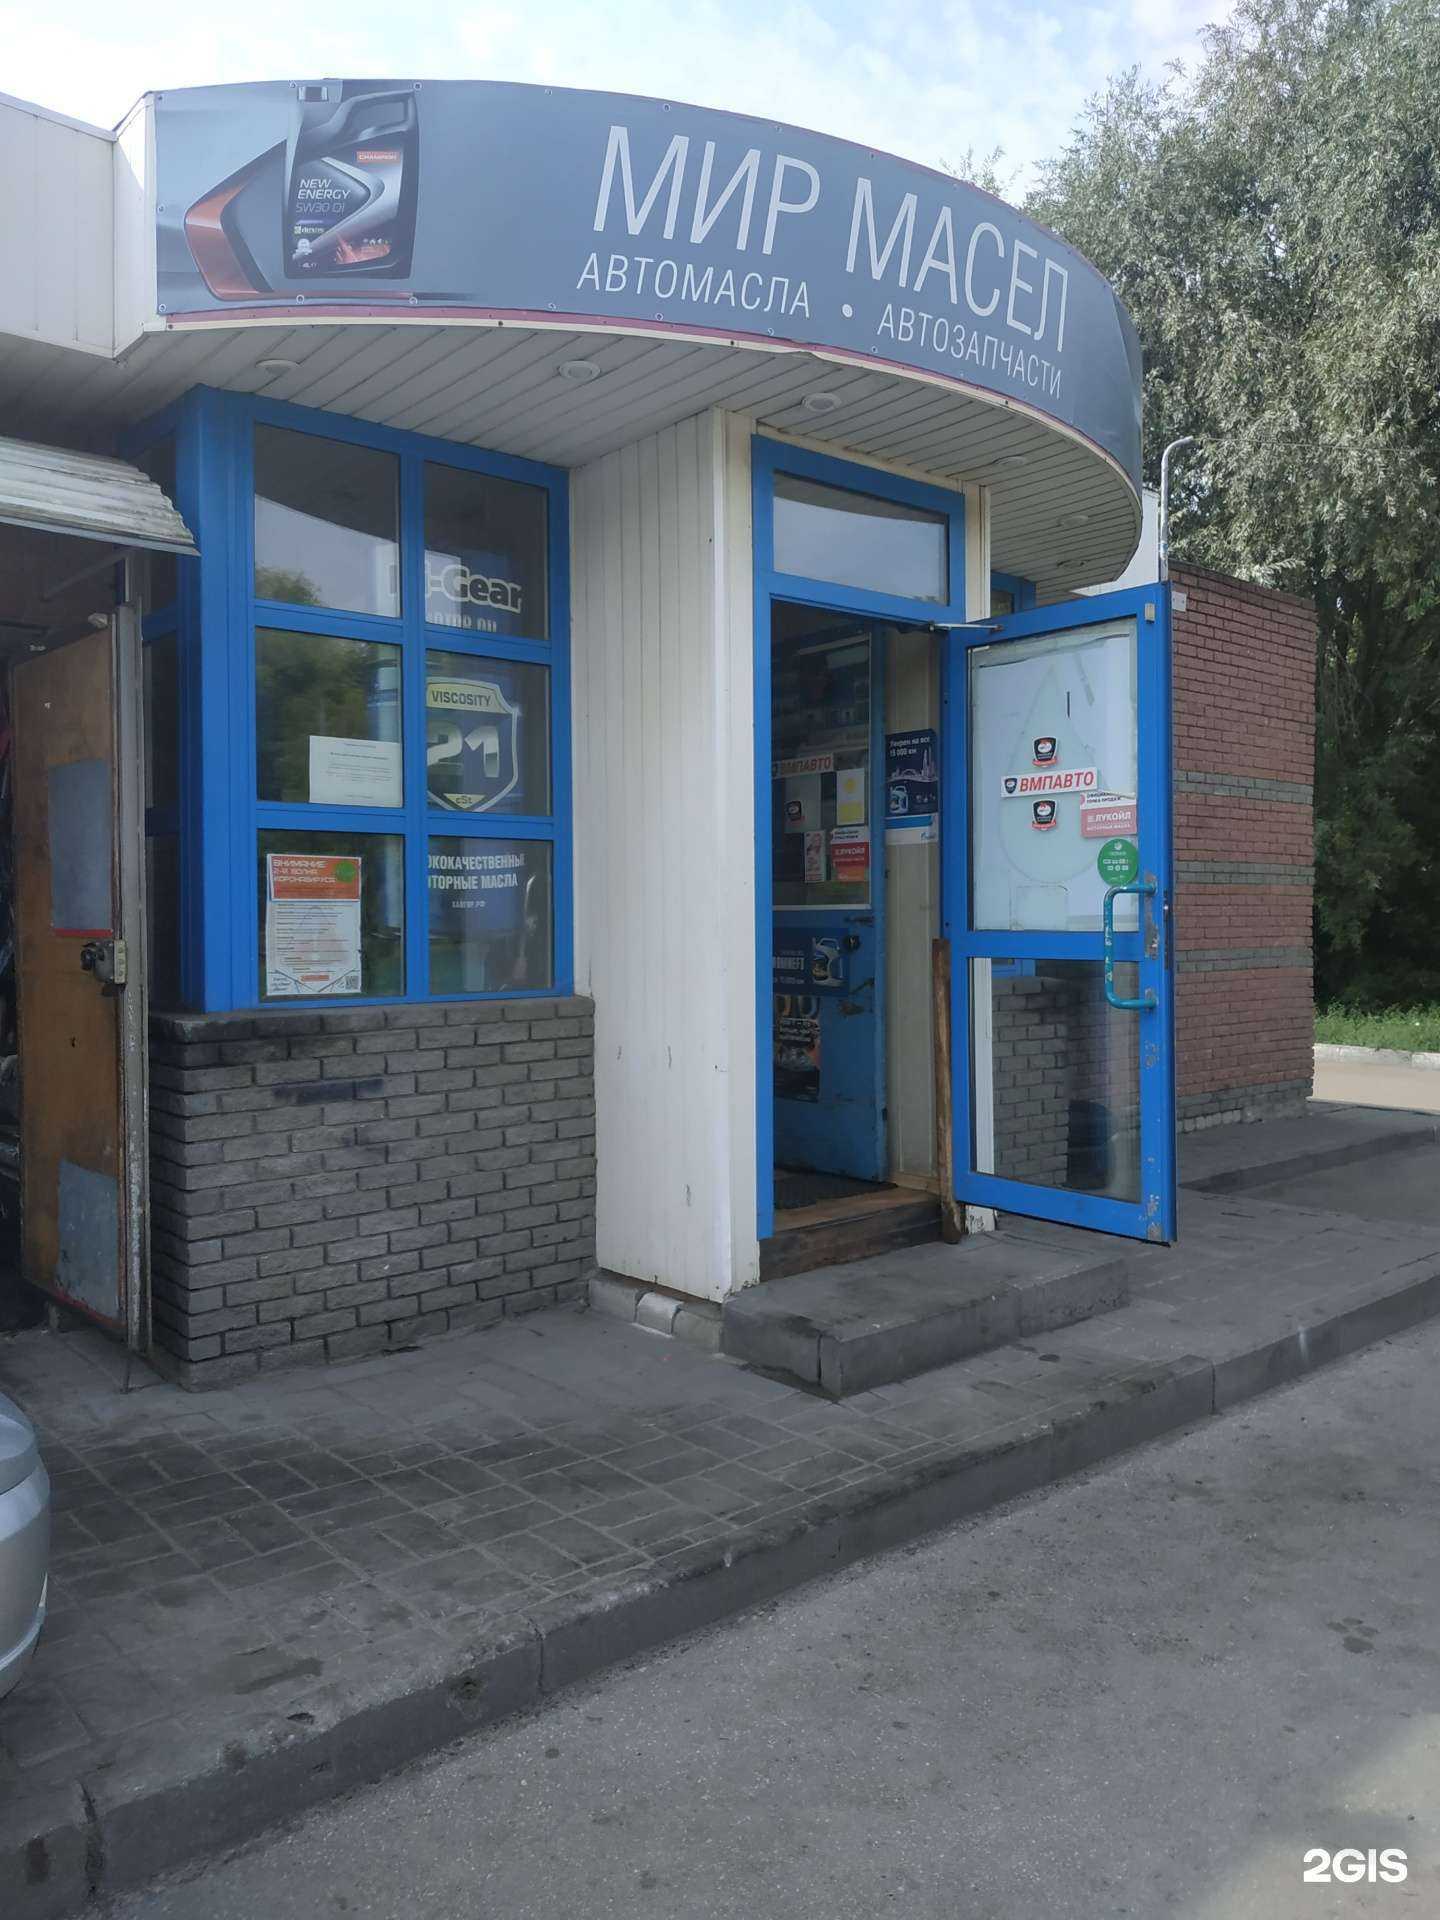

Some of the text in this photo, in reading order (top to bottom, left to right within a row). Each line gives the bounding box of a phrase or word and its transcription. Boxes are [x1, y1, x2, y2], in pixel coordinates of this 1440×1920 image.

[300, 179, 332, 189] NEW
[297, 189, 351, 200] ENERGY
[594, 126, 1068, 352] МИР МАСЕЛ
[577, 252, 1062, 399] АВТОМАСЛА АВТОЗАПЧАСТИ
[431, 689, 492, 707] VISCOSITY
[427, 720, 500, 778] 21
[1020, 771, 1094, 792] ВМПАВТО
[1096, 811, 1131, 822] ЛУКОЙЛ
[481, 873, 518, 889] МАСЛА
